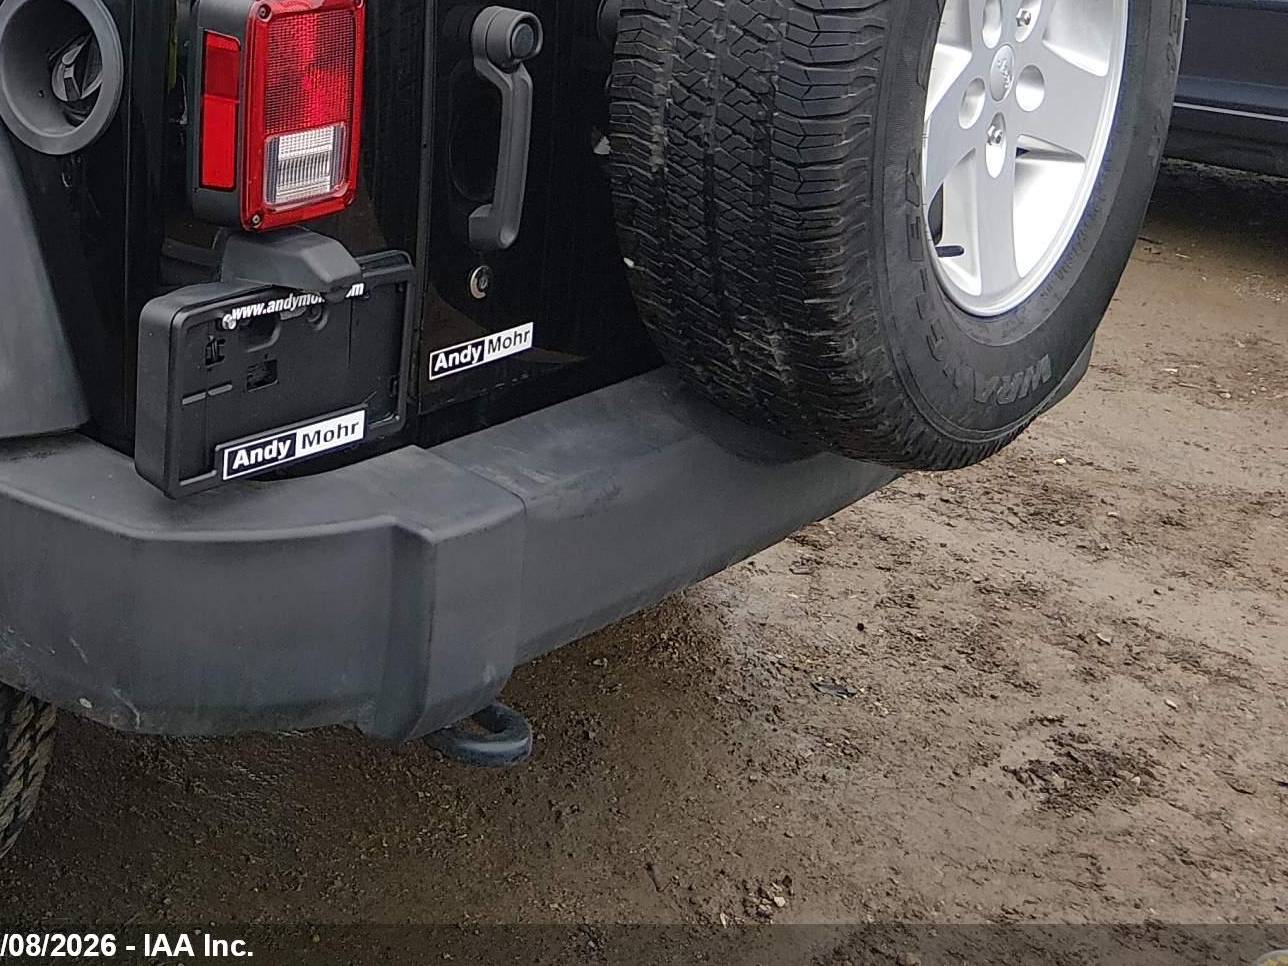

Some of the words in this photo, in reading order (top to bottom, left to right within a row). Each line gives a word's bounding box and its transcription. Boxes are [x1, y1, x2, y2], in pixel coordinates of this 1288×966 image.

[434, 344, 482, 372] Andy
[487, 330, 530, 355] Mohr
[232, 437, 291, 470] Andy
[301, 421, 359, 450] Mohr
